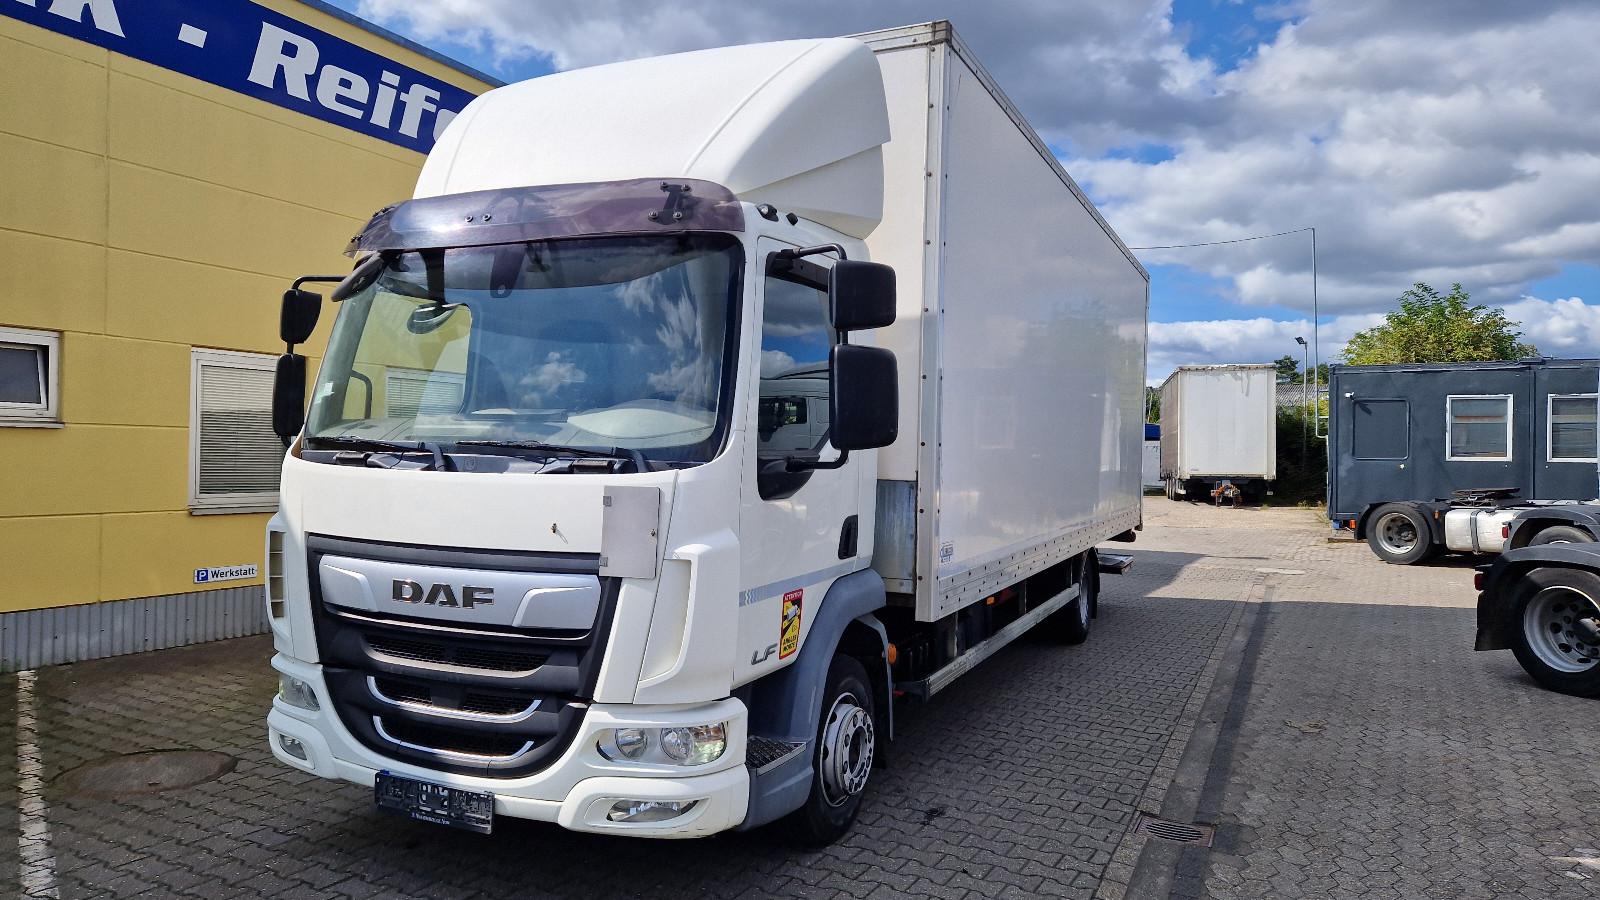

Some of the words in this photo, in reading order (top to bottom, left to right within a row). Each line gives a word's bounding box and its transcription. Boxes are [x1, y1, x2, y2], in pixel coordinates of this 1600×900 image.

[199, 570, 207, 581] P
[211, 568, 255, 579] Werkstatt
[392, 578, 494, 609] DAF
[751, 643, 778, 666] LF
